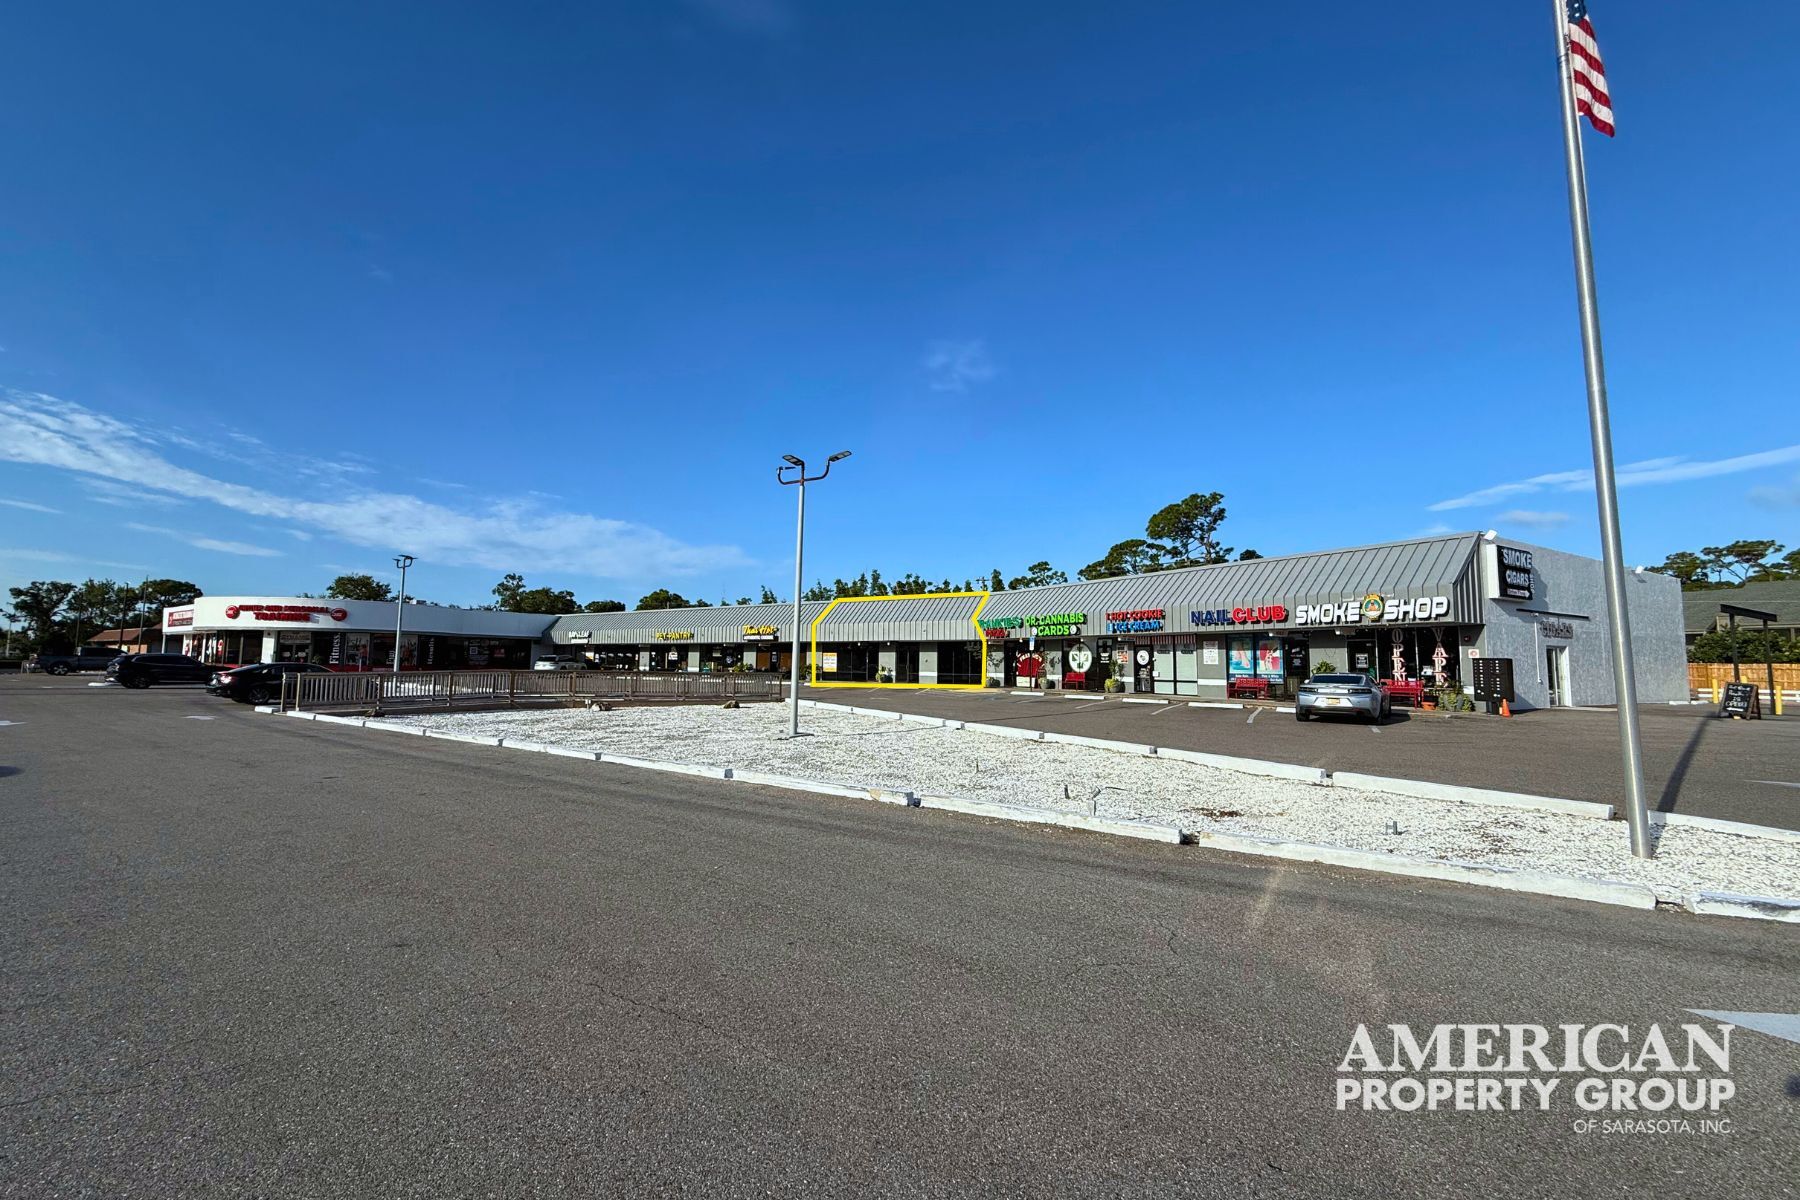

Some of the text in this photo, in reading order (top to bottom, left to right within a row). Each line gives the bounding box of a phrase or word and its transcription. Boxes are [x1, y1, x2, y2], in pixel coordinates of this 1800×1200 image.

[1503, 549, 1532, 569] SMOKE
[1506, 570, 1529, 588] CIGARS
[1040, 613, 1084, 625] CANNABIS
[1111, 611, 1127, 620] HOT
[1130, 609, 1162, 619] COOKIE
[1191, 605, 1286, 624] NAIL CLUB
[1295, 596, 1448, 624] SMOKE SHOP
[1037, 625, 1070, 636] CARDS
[1130, 621, 1160, 631] CREAM
[656, 631, 691, 640] PET PANTRY
[1391, 628, 1407, 687] OPEN
[1431, 627, 1449, 687] VAPE
